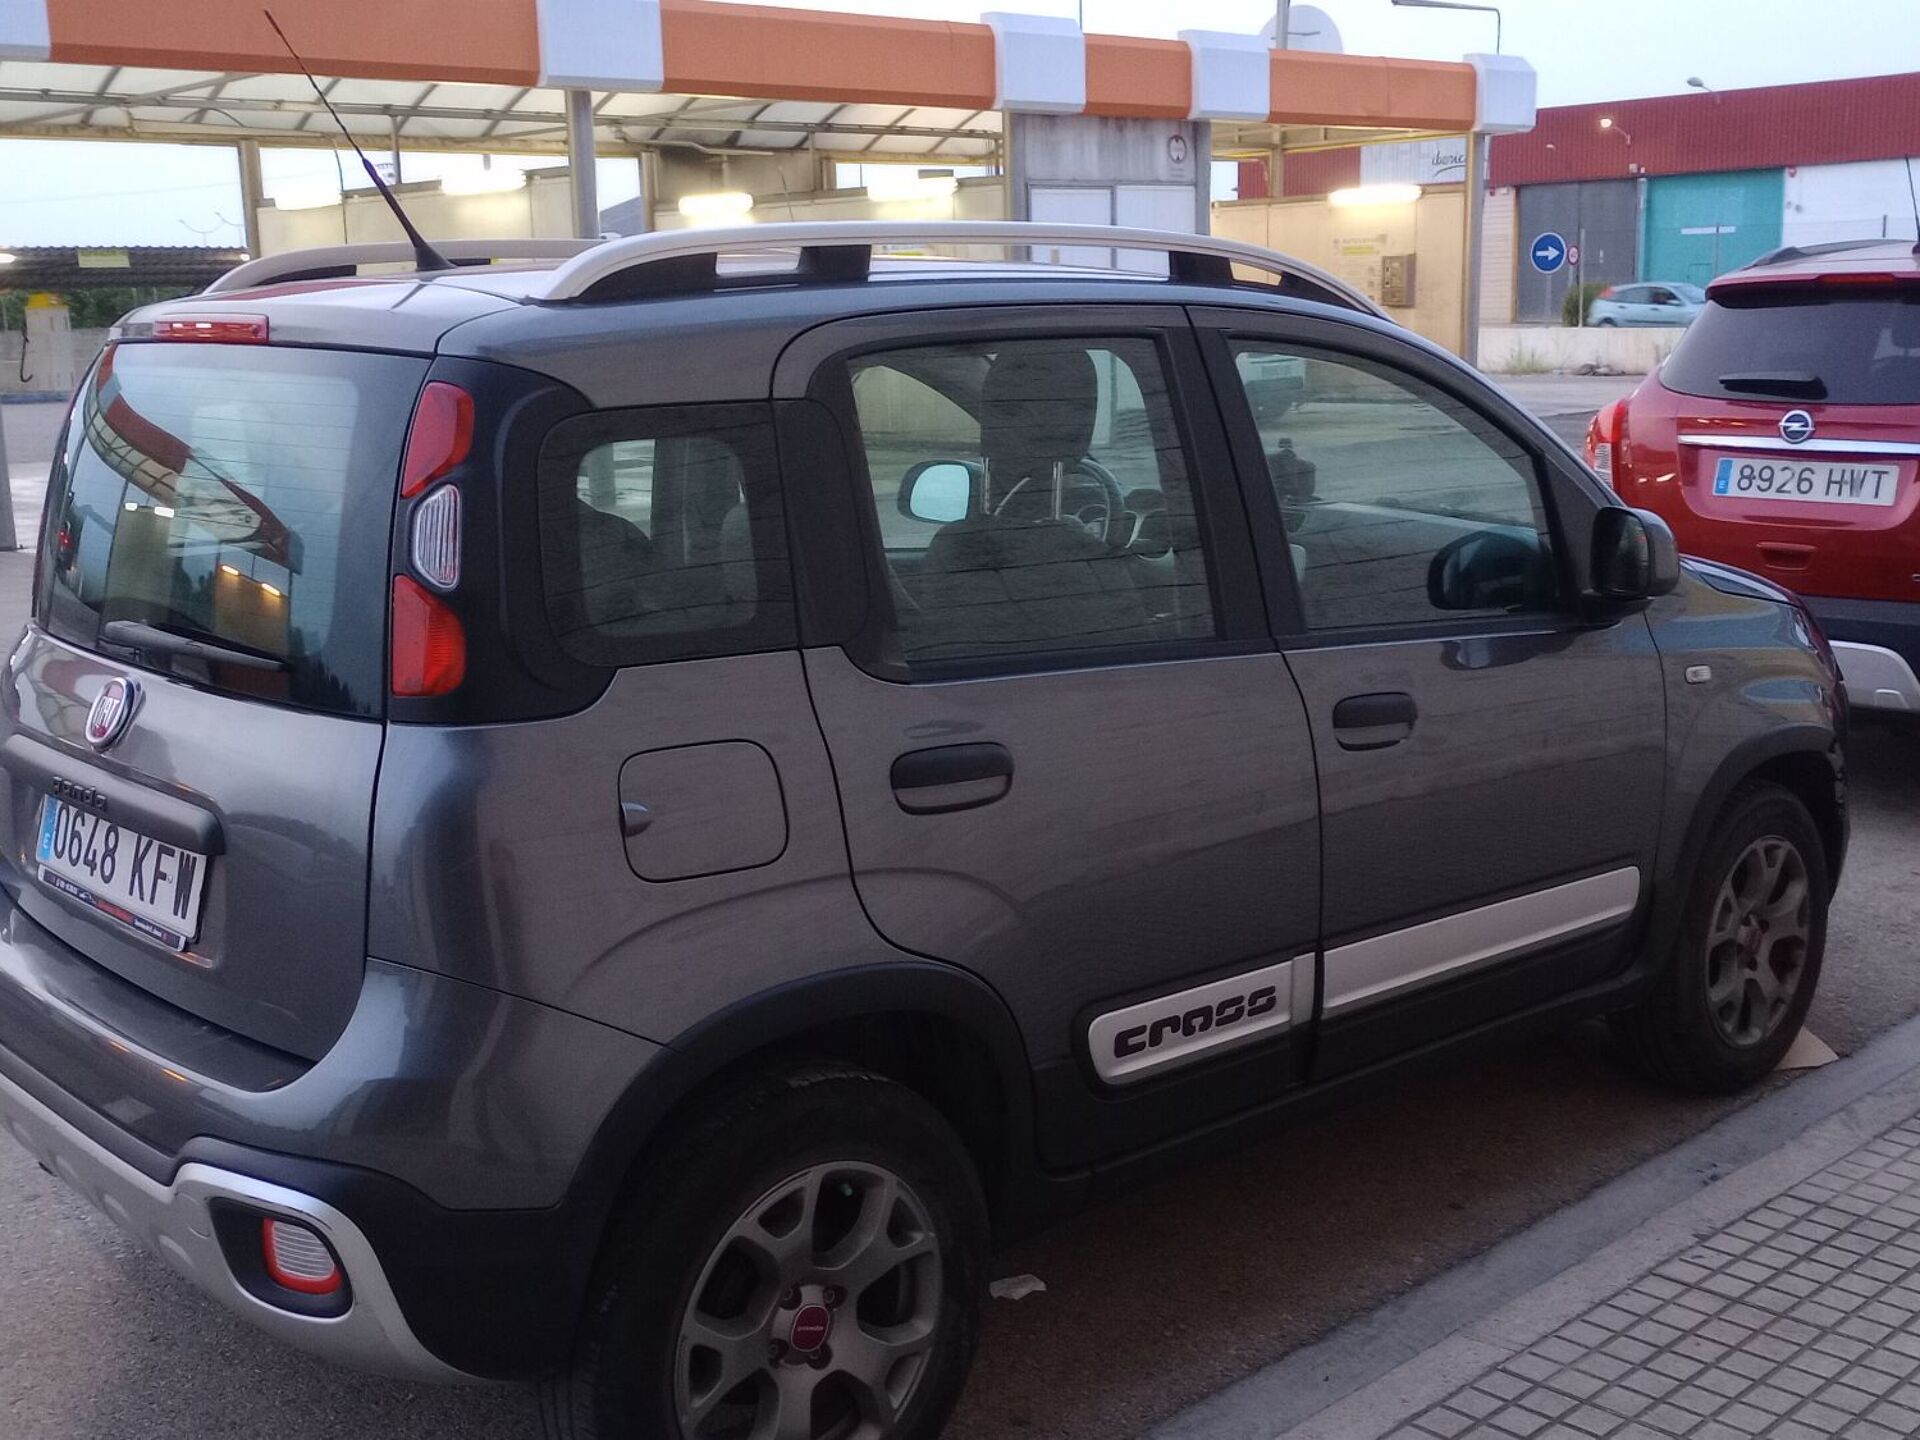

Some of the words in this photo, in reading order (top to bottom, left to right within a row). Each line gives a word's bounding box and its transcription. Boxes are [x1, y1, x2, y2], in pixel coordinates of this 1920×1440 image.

[1737, 465, 1815, 495] 8926
[54, 803, 119, 884] 0648
[129, 833, 197, 920] KFW
